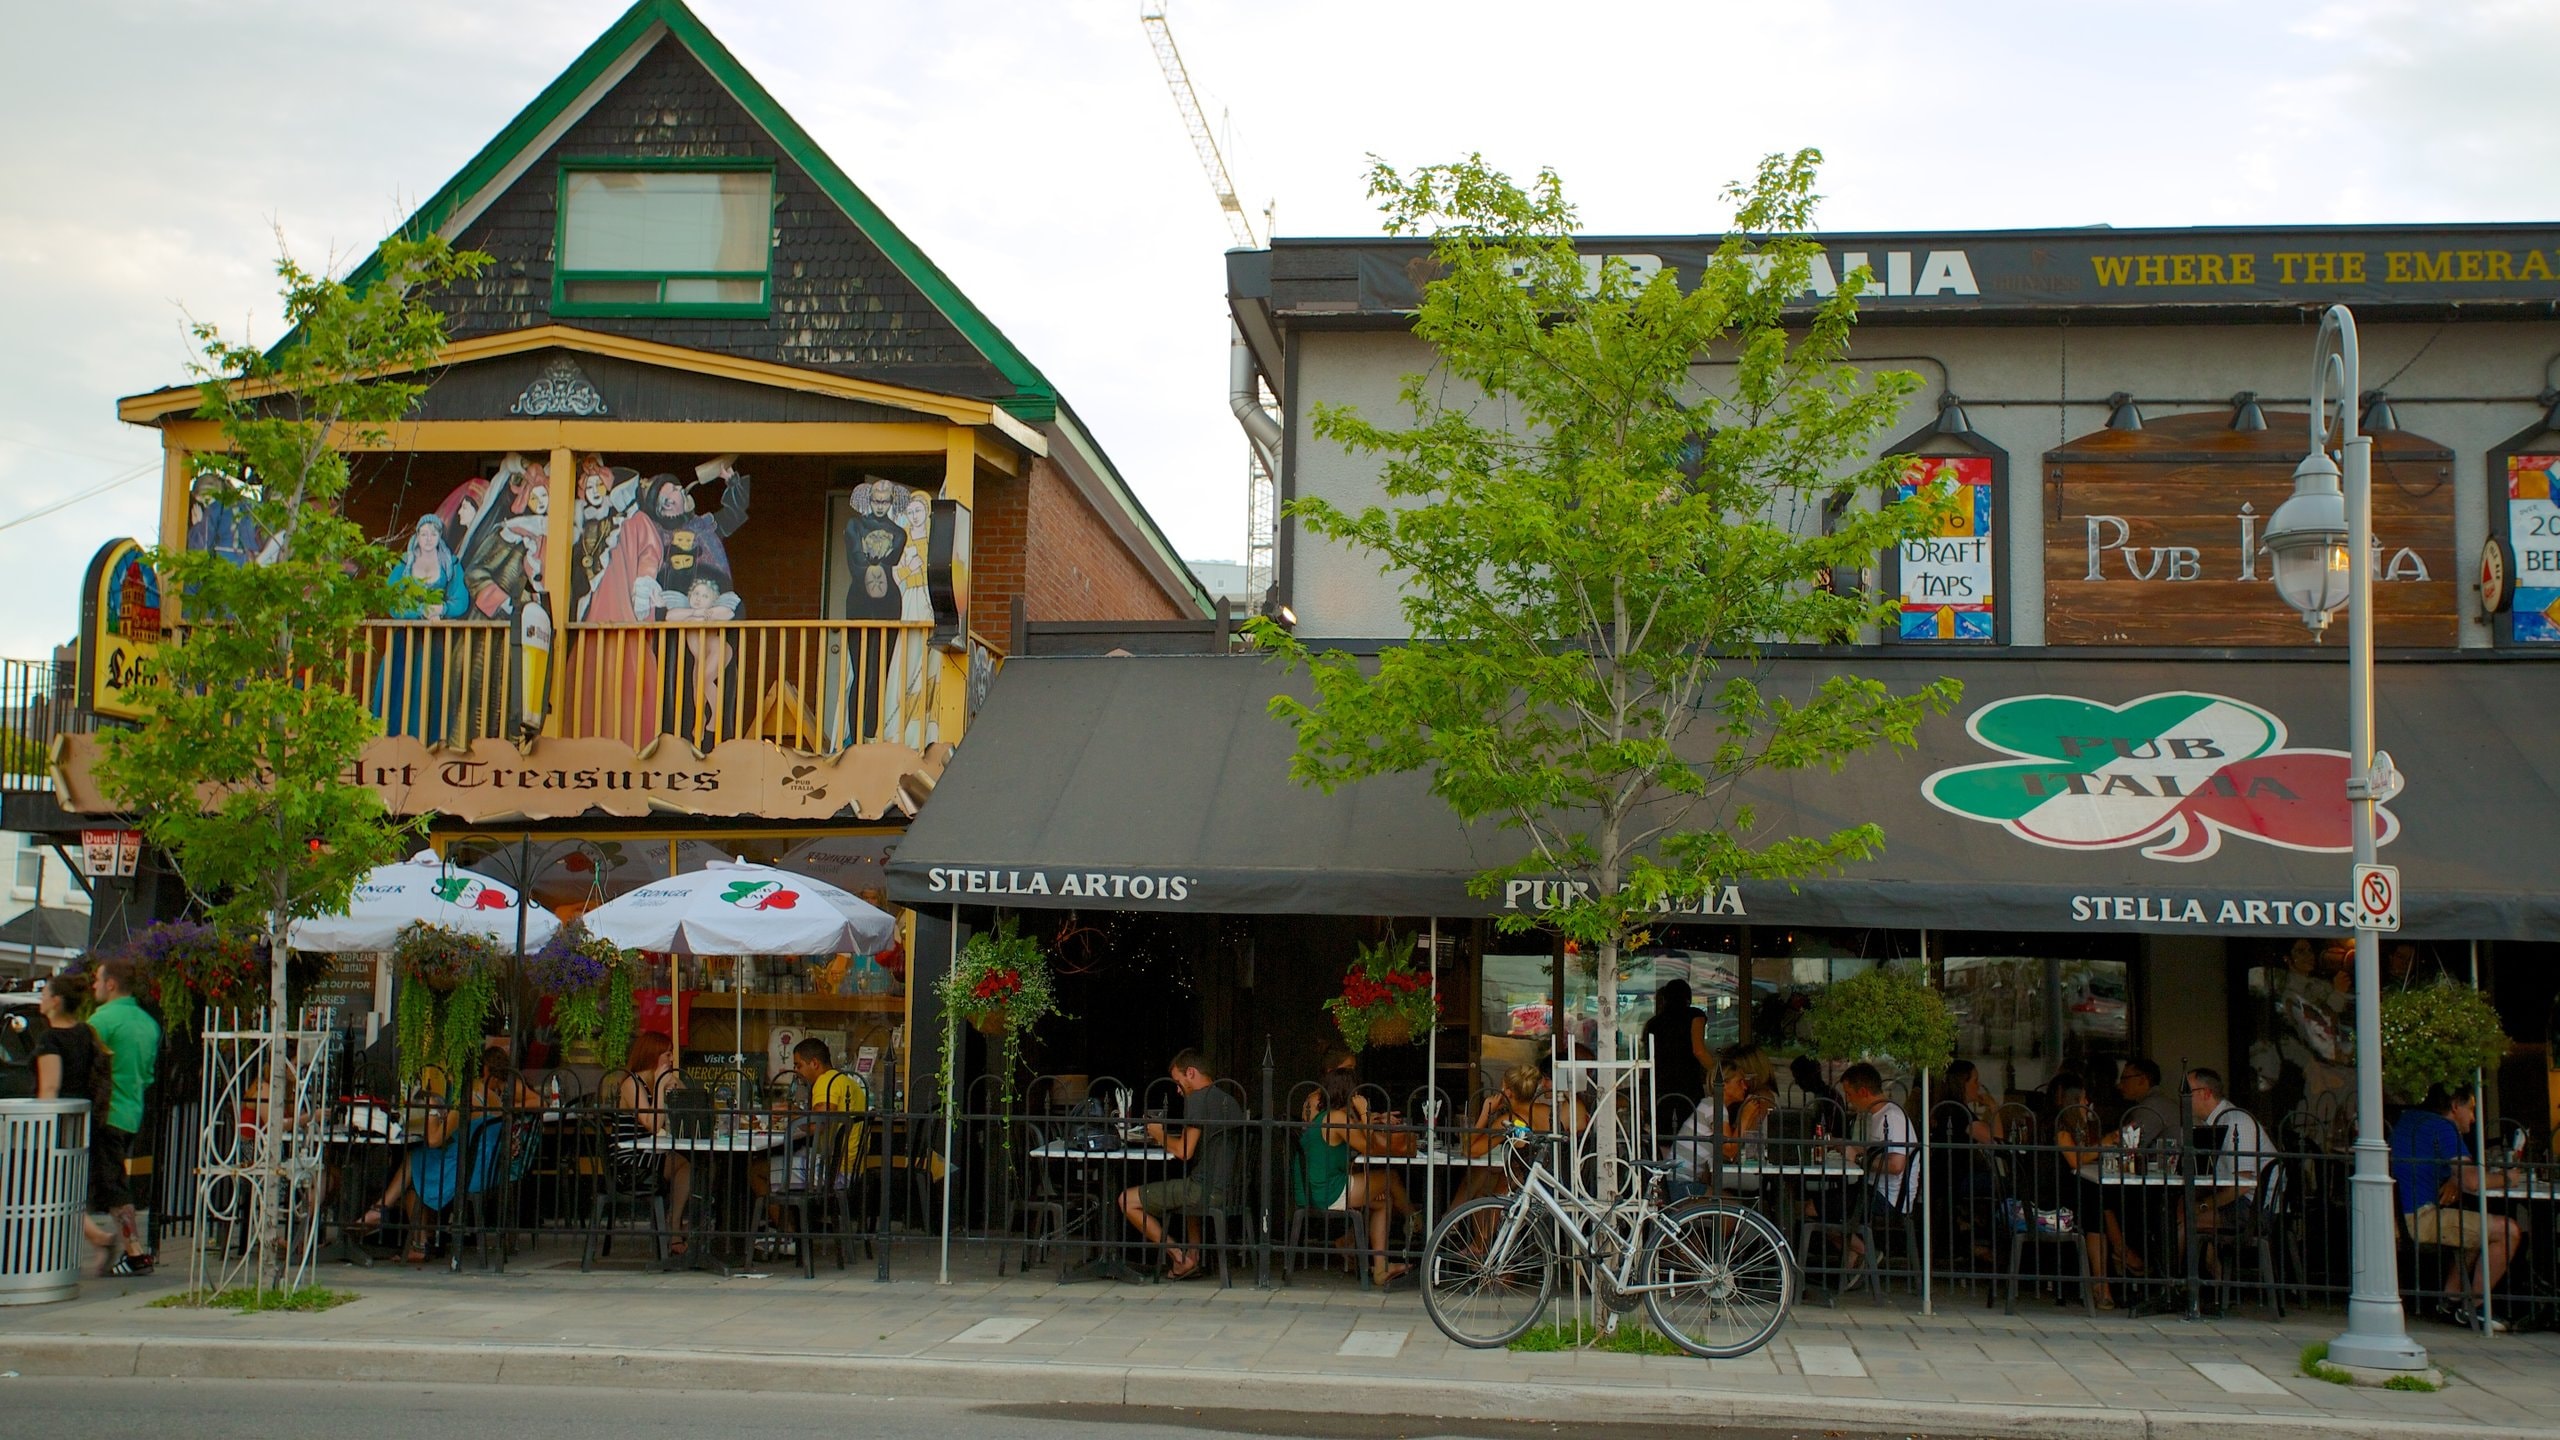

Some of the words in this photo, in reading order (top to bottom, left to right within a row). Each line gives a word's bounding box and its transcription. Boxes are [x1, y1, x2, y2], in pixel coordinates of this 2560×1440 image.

[2091, 254, 2256, 286] WHERE
[2273, 252, 2366, 284] THE
[2385, 249, 2560, 283] EMERA
[1909, 538, 1987, 566] DRAFT
[2084, 515, 2200, 581] PUB
[2237, 501, 2431, 581] IIA
[1917, 572, 1973, 597] TAPS
[2057, 734, 2226, 760] PUB
[438, 760, 721, 792] Treasures
[2019, 772, 2304, 800] ITALIA
[928, 868, 1051, 895] STELLA
[1618, 884, 1747, 916] ALIA
[2071, 895, 2208, 923] STELLA
[2216, 899, 2355, 928] ARTOIS
[303, 994, 346, 1005] LASSES
[351, 982, 370, 990] FOR
[311, 1019, 334, 1028] TPS
[704, 1054, 725, 1064] Visit
[728, 1054, 747, 1064] Or
